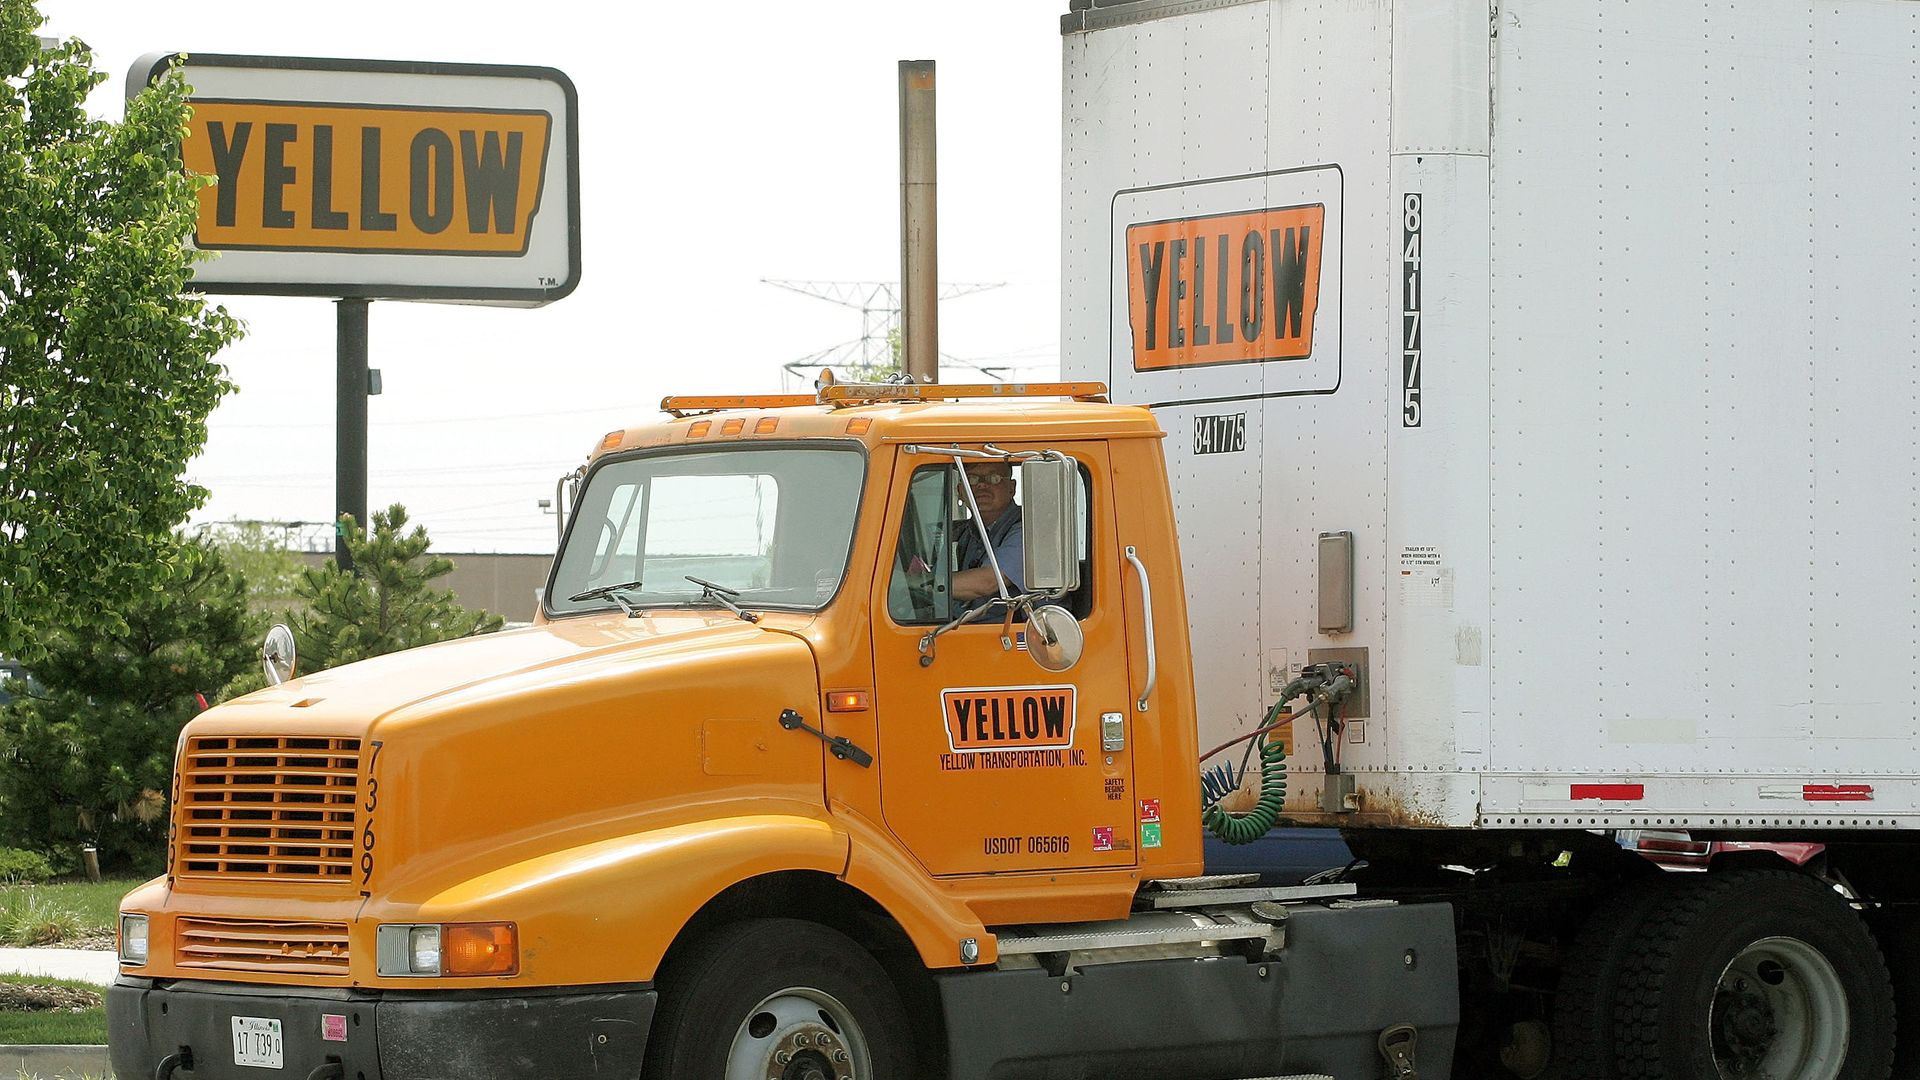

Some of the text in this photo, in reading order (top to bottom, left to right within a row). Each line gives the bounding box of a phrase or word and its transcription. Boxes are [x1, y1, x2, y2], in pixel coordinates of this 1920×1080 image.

[206, 121, 523, 234] YELLOW
[538, 277, 559, 286] T.M.
[1139, 225, 1310, 350] YELLOW
[1403, 193, 1422, 428] 841775
[1194, 414, 1246, 454] 841775
[953, 696, 1065, 741] YELLOW
[940, 749, 1087, 770] YELLOW TRANSPORTATION, INC.
[1104, 778, 1124, 786] SAFETY
[355, 741, 383, 923] 73697
[984, 836, 1070, 855] USDOT 065616
[238, 1031, 249, 1054] 17
[255, 1033, 272, 1057] 739
